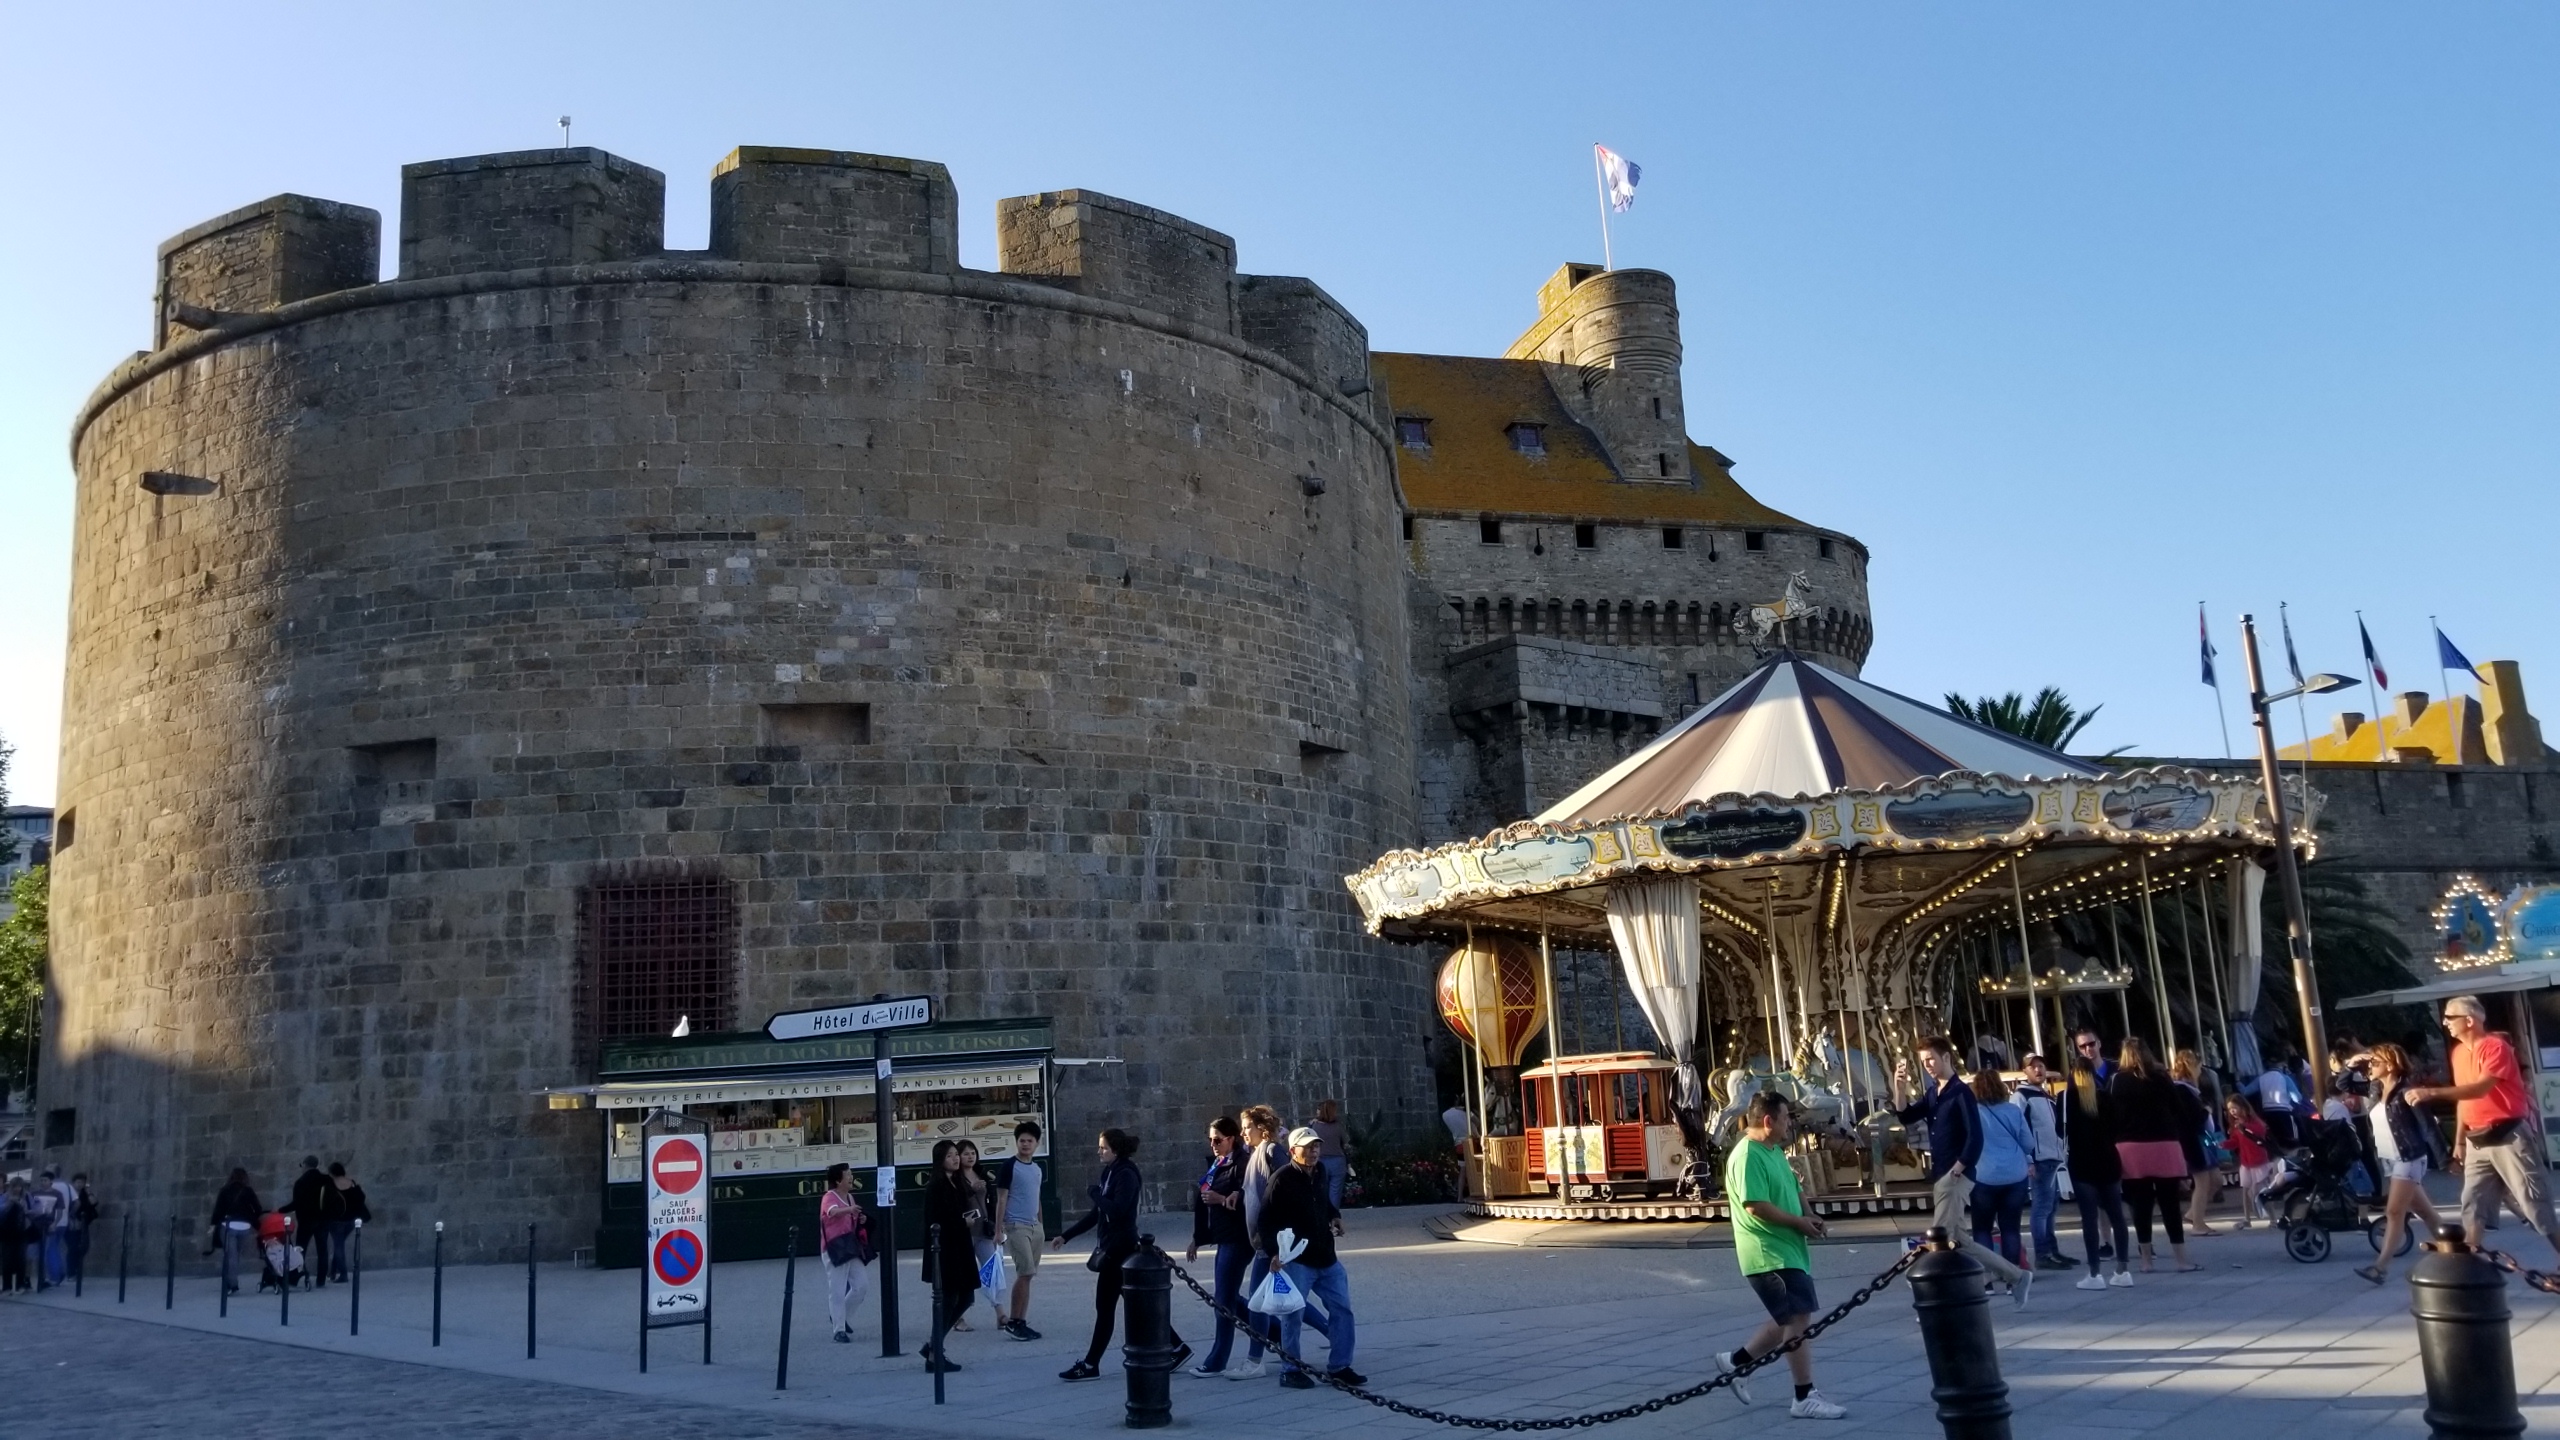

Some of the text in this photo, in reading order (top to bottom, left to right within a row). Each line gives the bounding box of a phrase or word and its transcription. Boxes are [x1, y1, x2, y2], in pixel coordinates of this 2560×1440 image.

[813, 1012, 853, 1031] Hôtel
[889, 1004, 924, 1022] Ville
[614, 1073, 1023, 1105] CONFISERIE GLACIER SANDWICHERIE
[669, 1199, 689, 1209] SAUF
[661, 1207, 696, 1217] USAGERS
[653, 1214, 703, 1225] DE LA MAIRIE
